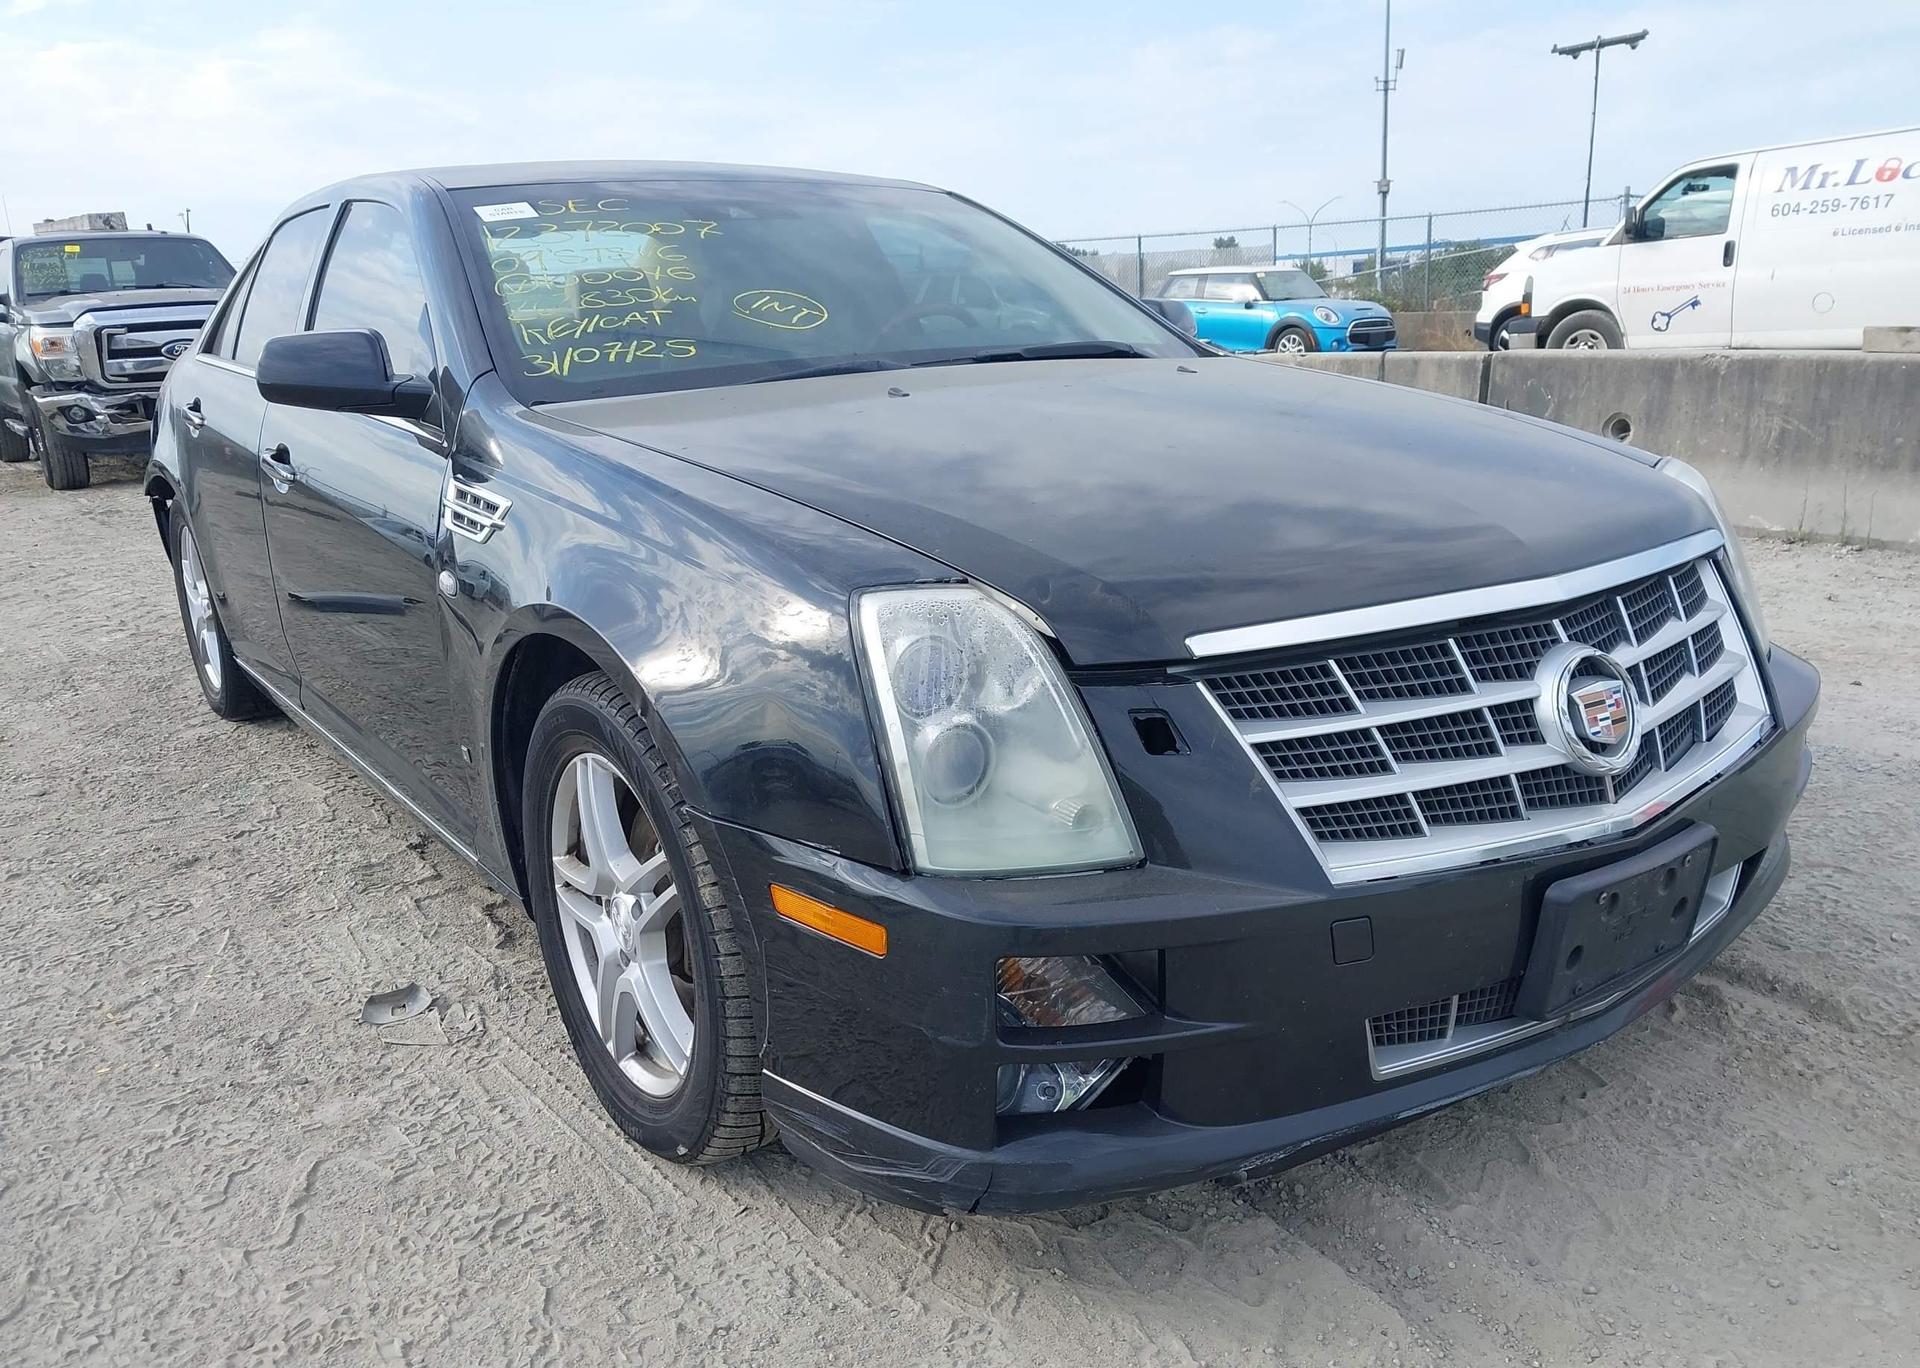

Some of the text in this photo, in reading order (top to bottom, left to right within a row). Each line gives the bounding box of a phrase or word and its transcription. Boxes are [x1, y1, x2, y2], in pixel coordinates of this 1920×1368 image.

[1774, 162, 1840, 193] Mr.
[537, 198, 629, 216] SEC
[1771, 193, 1896, 217] 604-259-7617
[1841, 223, 1893, 237] Licensed
